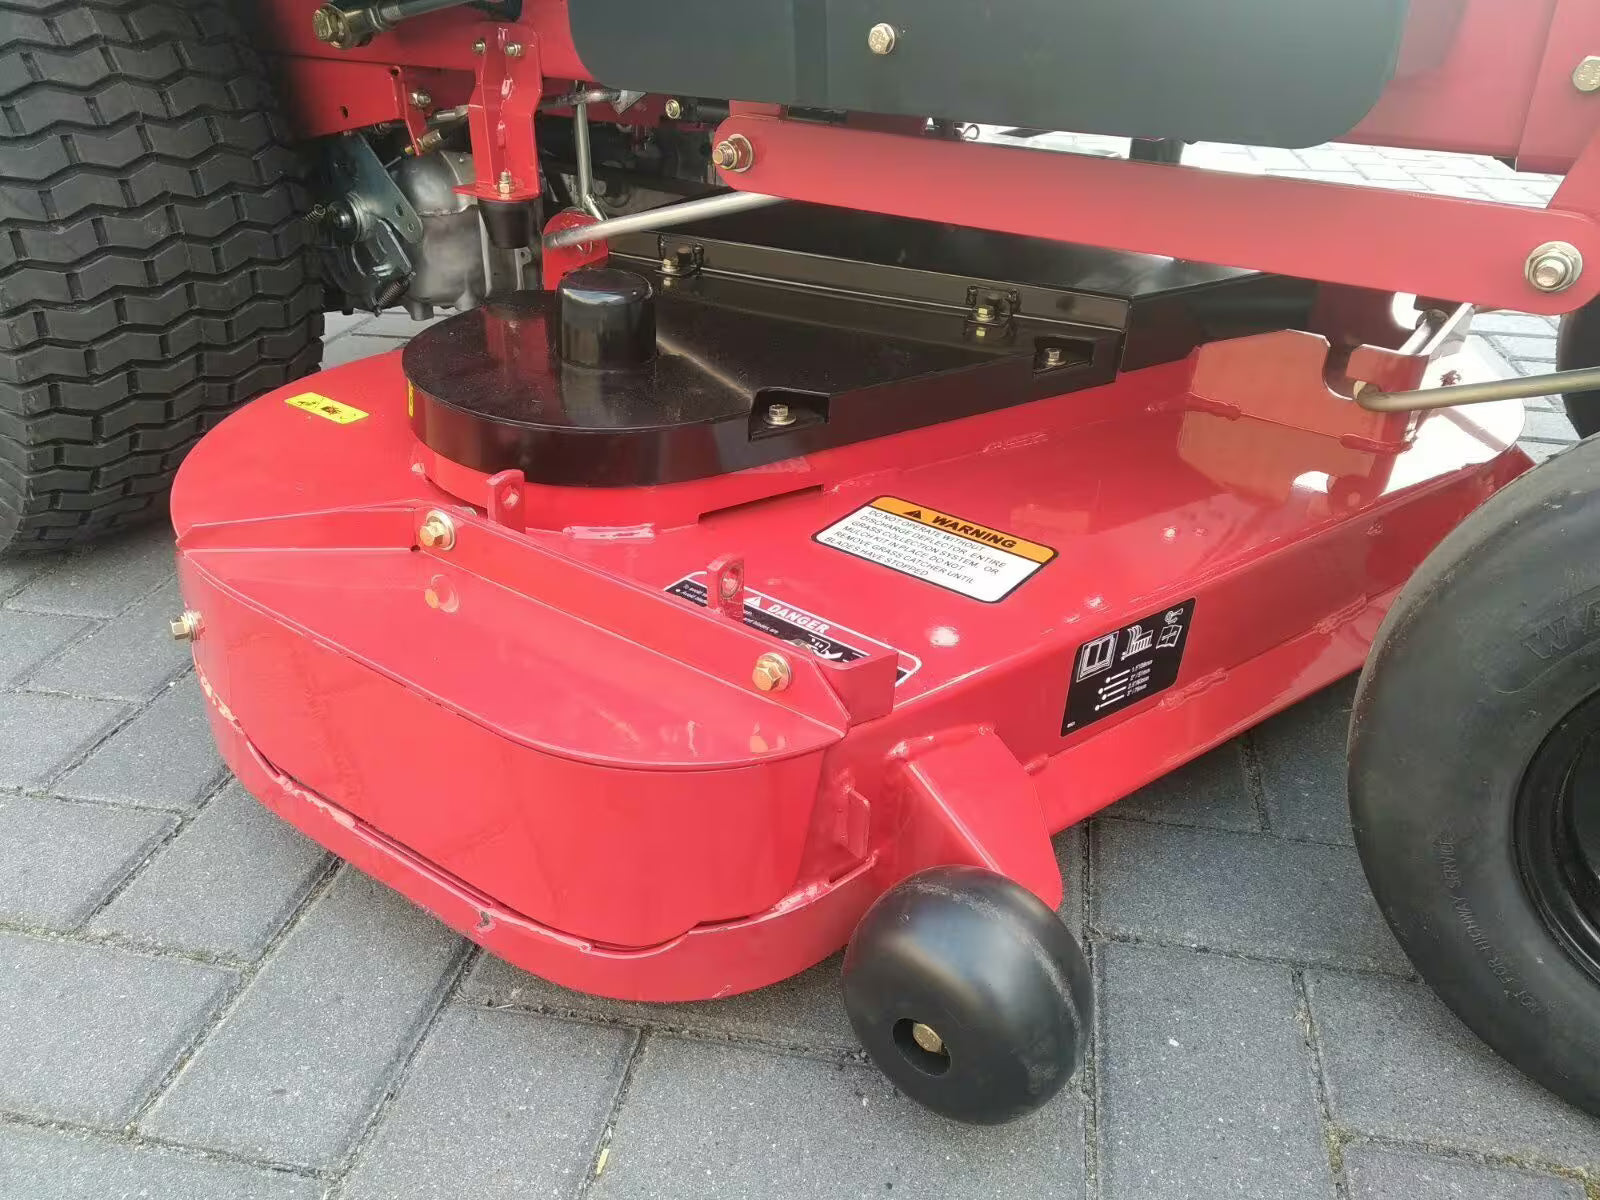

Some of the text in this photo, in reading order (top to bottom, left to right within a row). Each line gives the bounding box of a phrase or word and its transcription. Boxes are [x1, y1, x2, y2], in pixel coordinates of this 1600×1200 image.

[843, 526, 874, 539] MULCH
[873, 536, 889, 544] KIT
[929, 555, 944, 564] DO
[944, 561, 965, 570] NOT
[852, 521, 881, 534] GRASS
[882, 531, 939, 553] COLLECTION
[984, 566, 999, 575] OR
[860, 515, 912, 535] DISCHARGE
[970, 552, 1006, 568] ENTIRE
[869, 510, 985, 551] DO NOT OPERATE WITHOUT
[932, 515, 1017, 549] WARNING
[824, 536, 929, 576] BLADES HAVE STOPPED
[835, 531, 974, 584] REMOVE GRASS CATCHER UNTIL
[767, 604, 831, 634] DANGER
[1451, 895, 1491, 952] HIGHWAY
